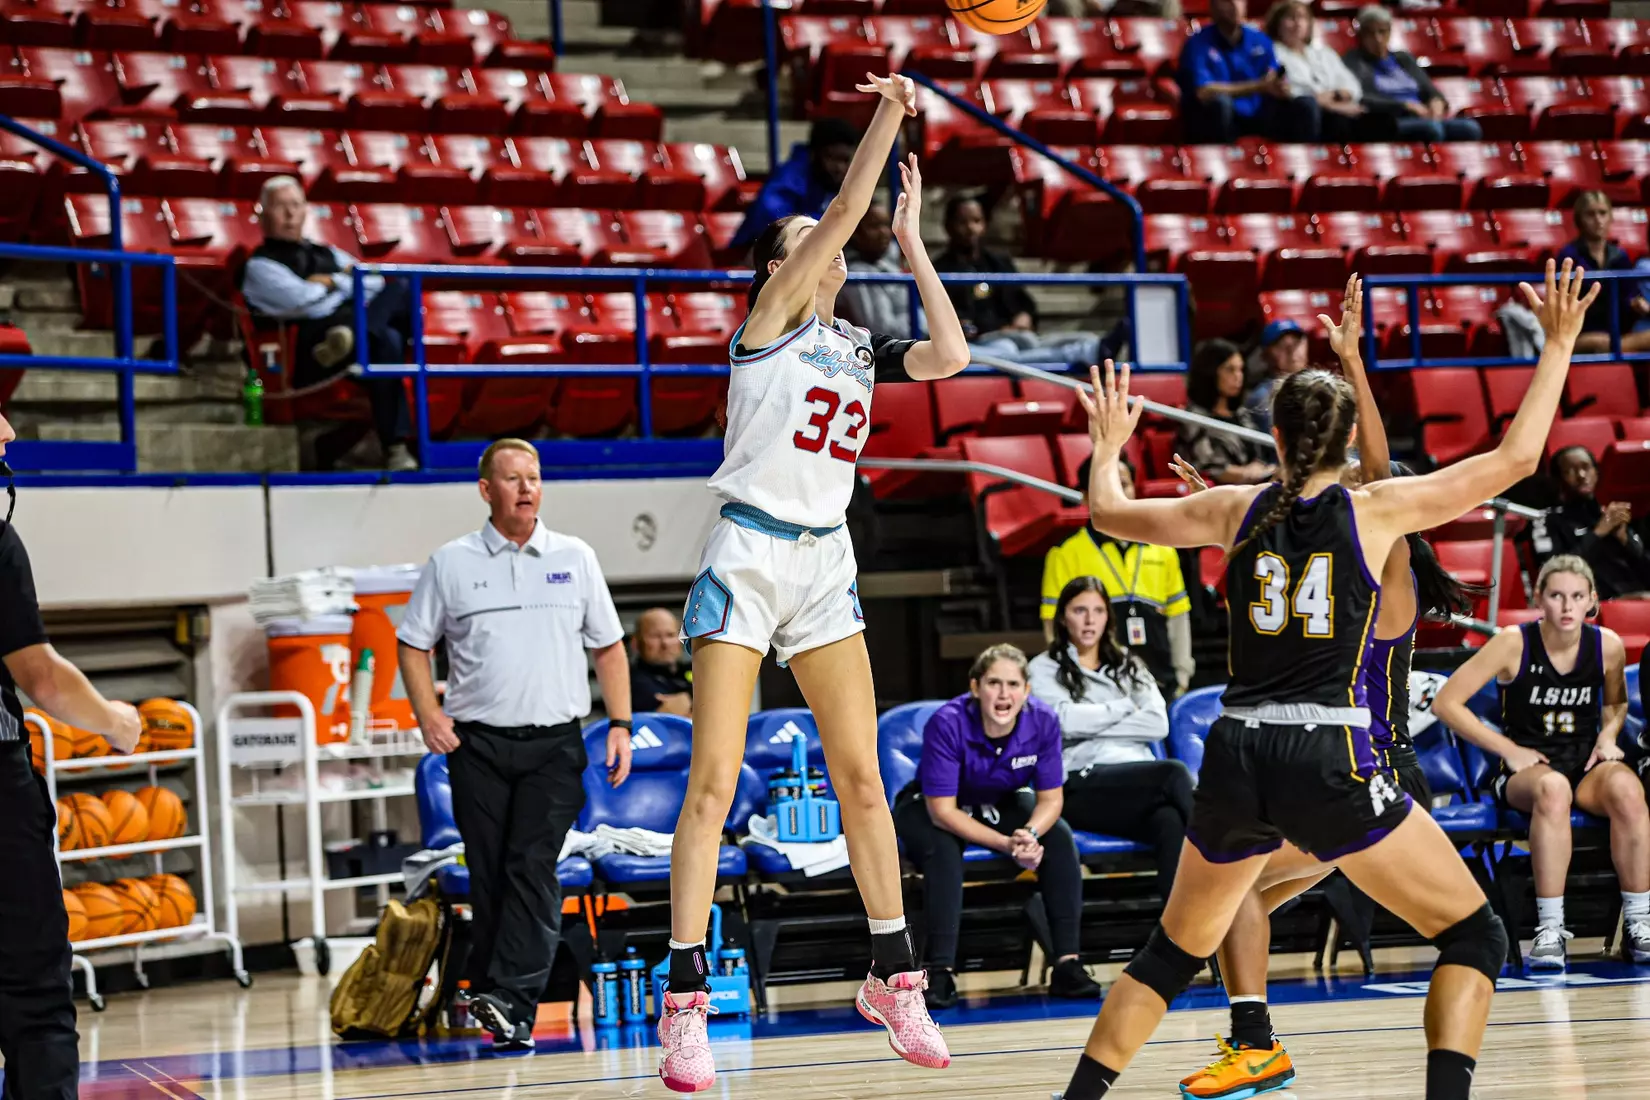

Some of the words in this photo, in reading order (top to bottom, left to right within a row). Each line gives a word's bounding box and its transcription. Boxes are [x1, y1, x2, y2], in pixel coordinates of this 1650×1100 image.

[799, 344, 842, 378] Lady
[793, 385, 867, 463] 33
[1249, 550, 1334, 638] 34
[1529, 685, 1592, 706] LSUA
